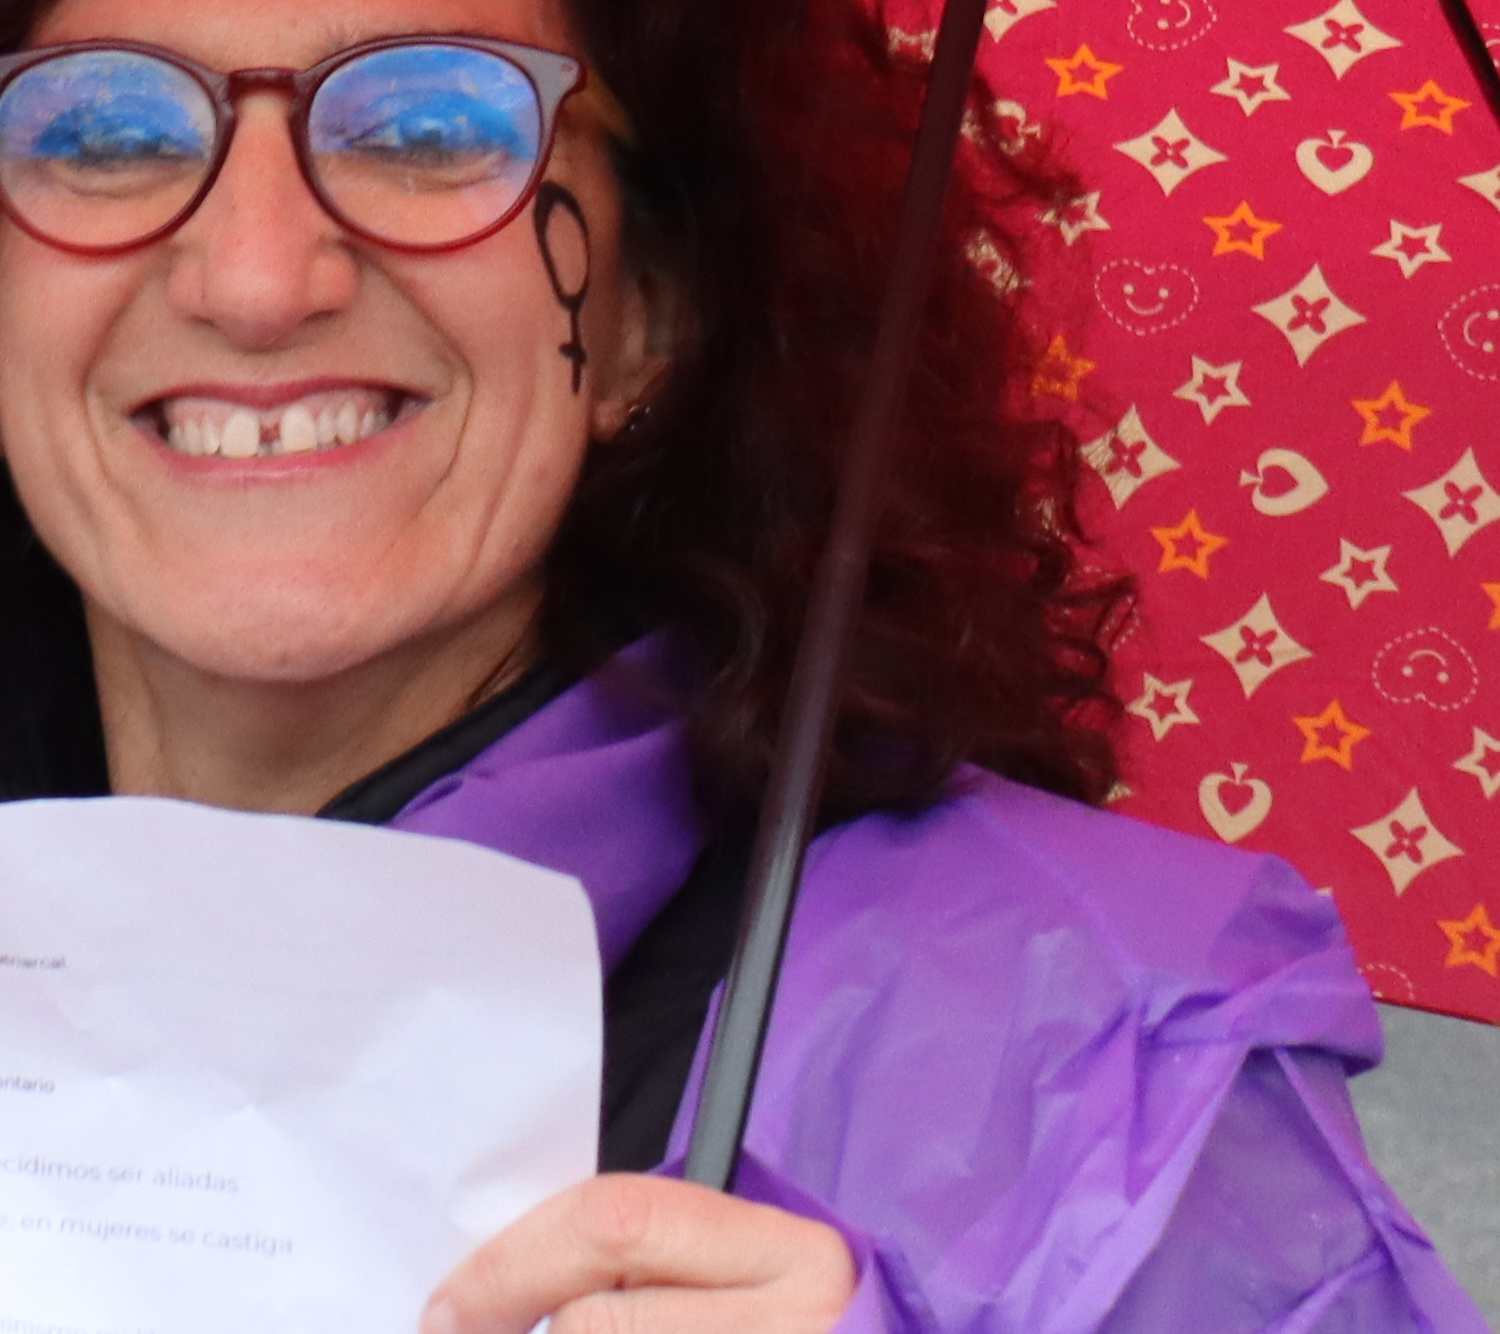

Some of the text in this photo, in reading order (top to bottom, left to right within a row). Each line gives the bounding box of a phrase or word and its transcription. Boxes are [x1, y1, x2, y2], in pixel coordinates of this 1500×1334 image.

[107, 1164, 145, 1185] ser
[151, 1162, 240, 1195] aliadas
[20, 1210, 52, 1233] en
[58, 1214, 162, 1243] mujeres
[168, 1225, 195, 1246] se
[202, 1229, 294, 1259] castiga
